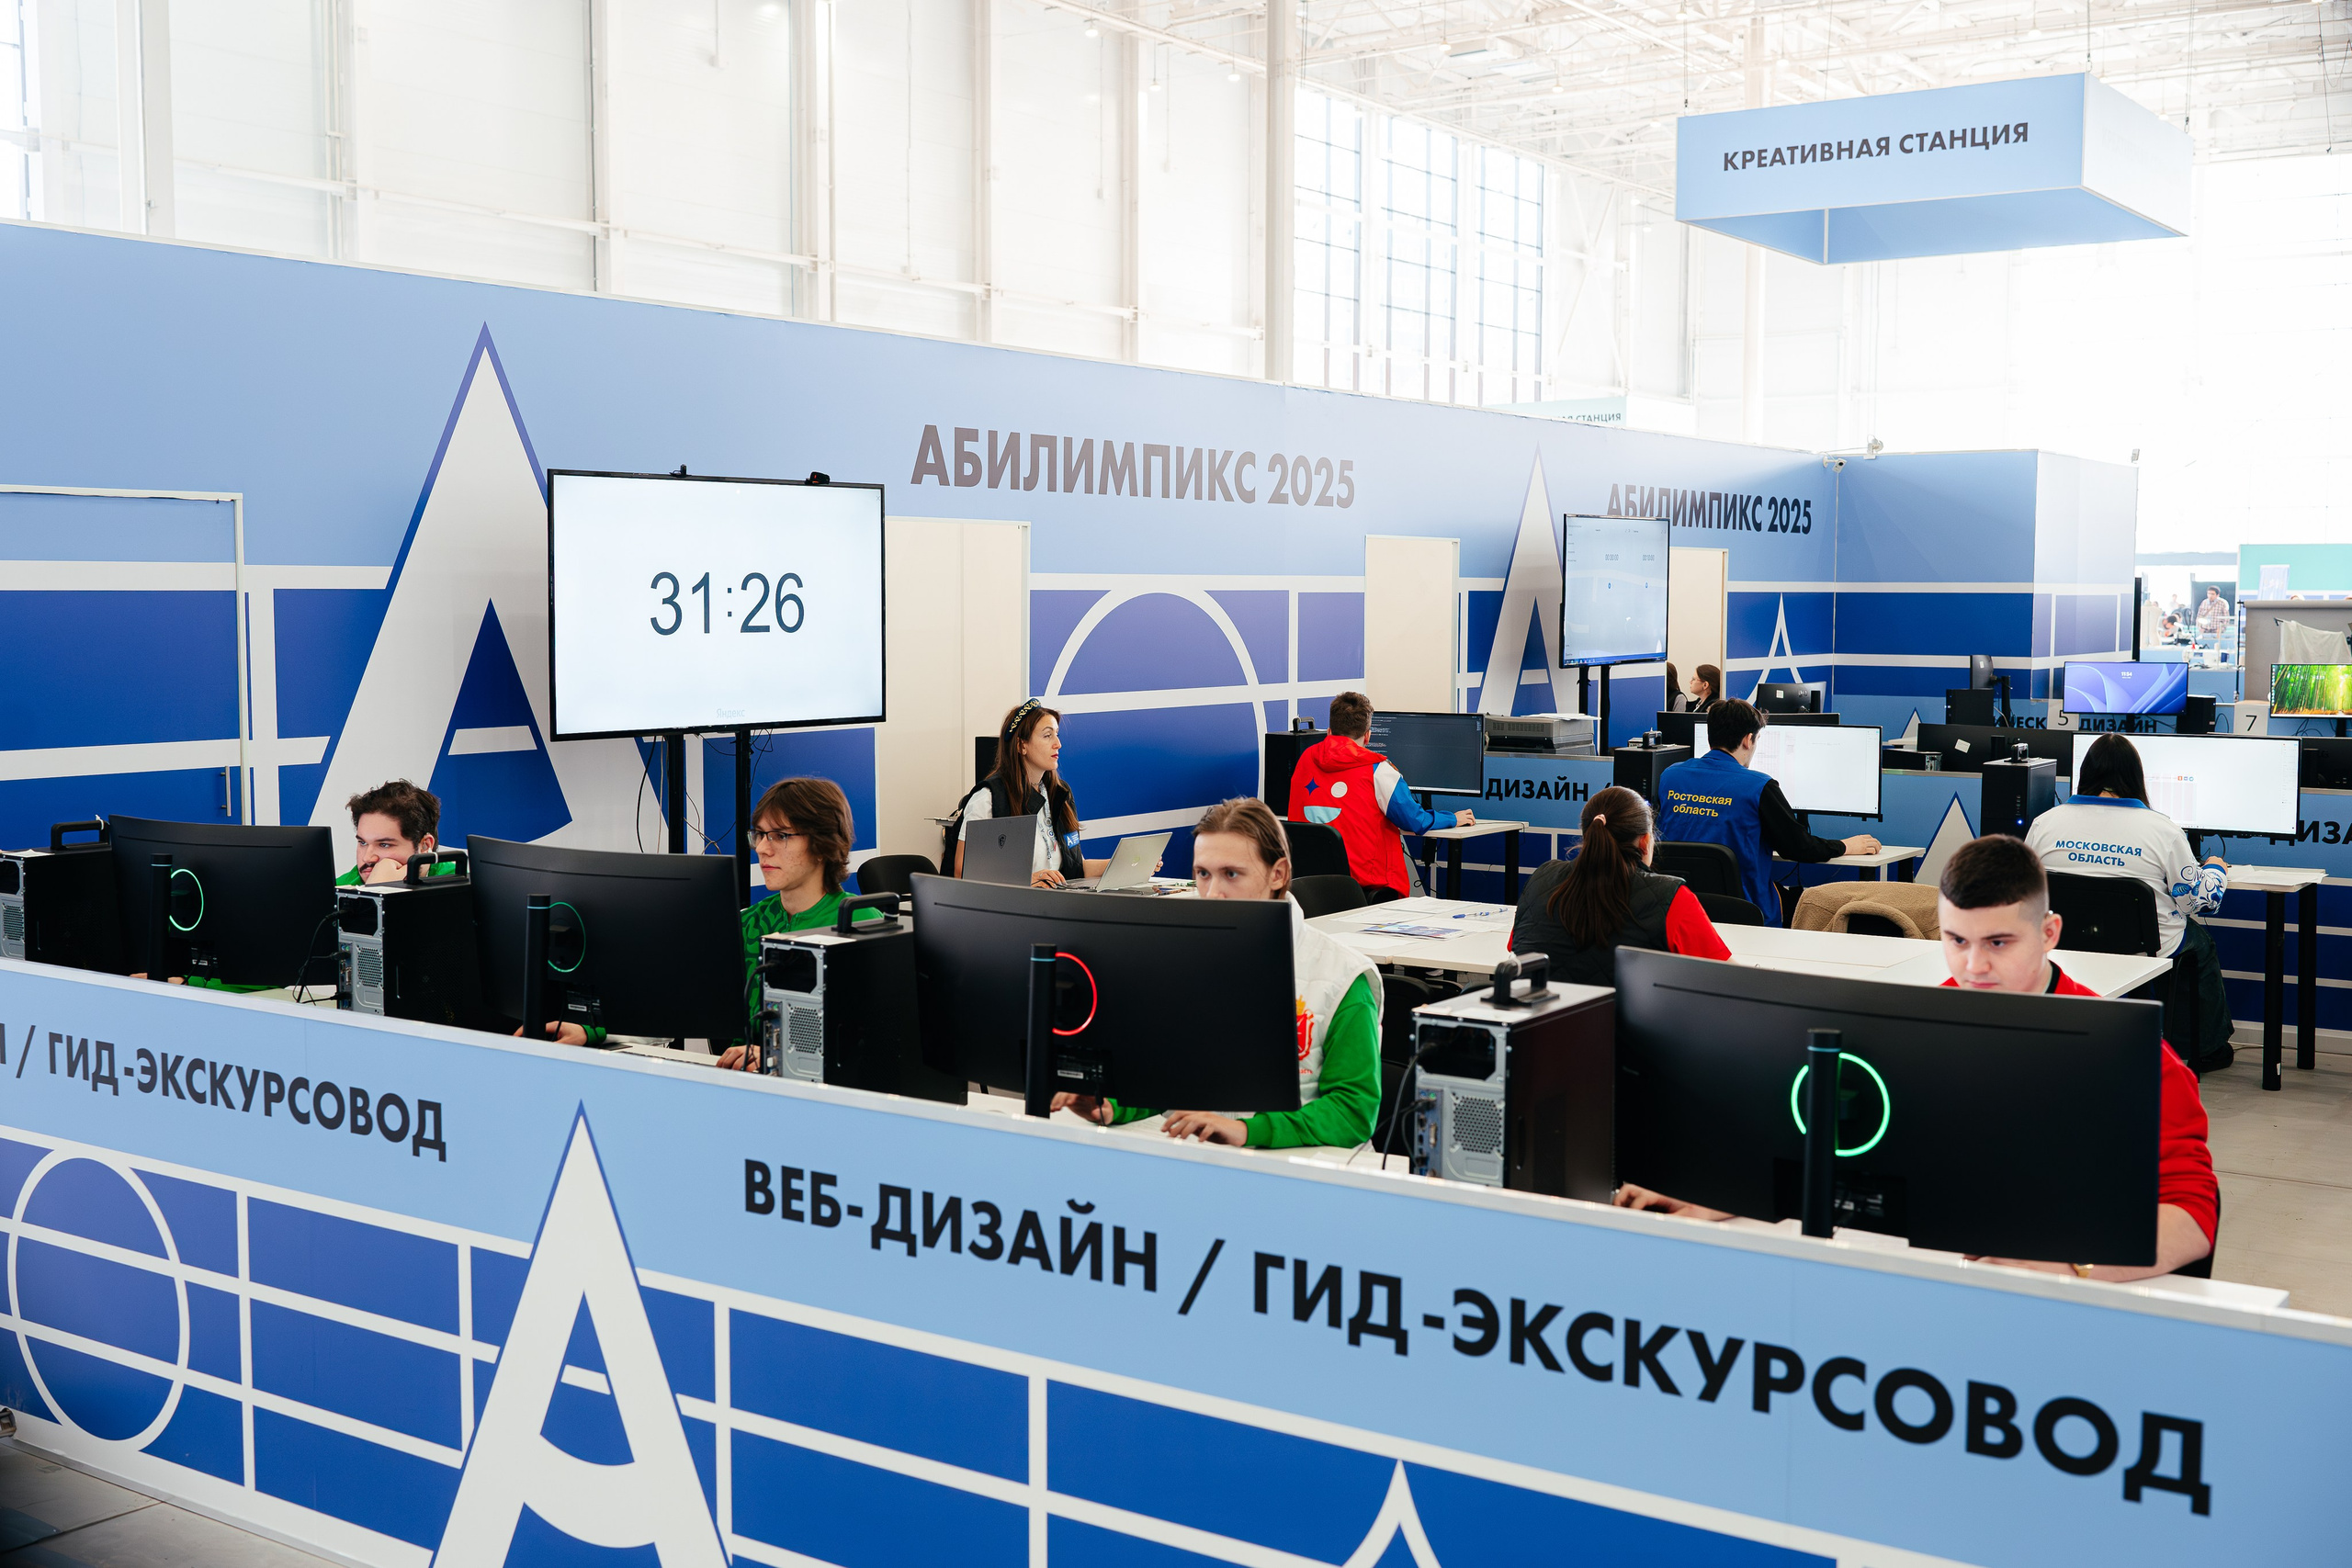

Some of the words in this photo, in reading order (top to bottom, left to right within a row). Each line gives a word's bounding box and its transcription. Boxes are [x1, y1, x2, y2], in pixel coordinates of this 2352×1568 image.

[1724, 136, 1891, 172] КРЕАТИВНАЯ
[1899, 122, 2030, 154] СТАНЦИЯ
[910, 424, 1256, 504] АБИЛИМПИКС
[1267, 453, 1355, 509] 2025
[1608, 483, 1763, 533] АБИЛИМПИКС
[1767, 496, 1812, 536] 2025
[650, 571, 805, 636] 31:26
[716, 708, 746, 719] Яндекс
[2058, 710, 2069, 726] 5
[2245, 715, 2257, 731] 7
[1485, 776, 1589, 802] ДИЗАЙН
[1668, 790, 1733, 807] Ростовская
[1673, 804, 1719, 818] область
[2055, 840, 2143, 857] МОСКОВСКАЯ
[2067, 852, 2126, 867] ОБЛАСТЬ
[49, 1032, 447, 1163] ГИД-ЭКСКУРСОВОД
[744, 1158, 1158, 1293] ВЕБ-ДИЗАЙН
[1253, 1250, 2211, 1518] ГИД-ЭКСКУРСОВОД
